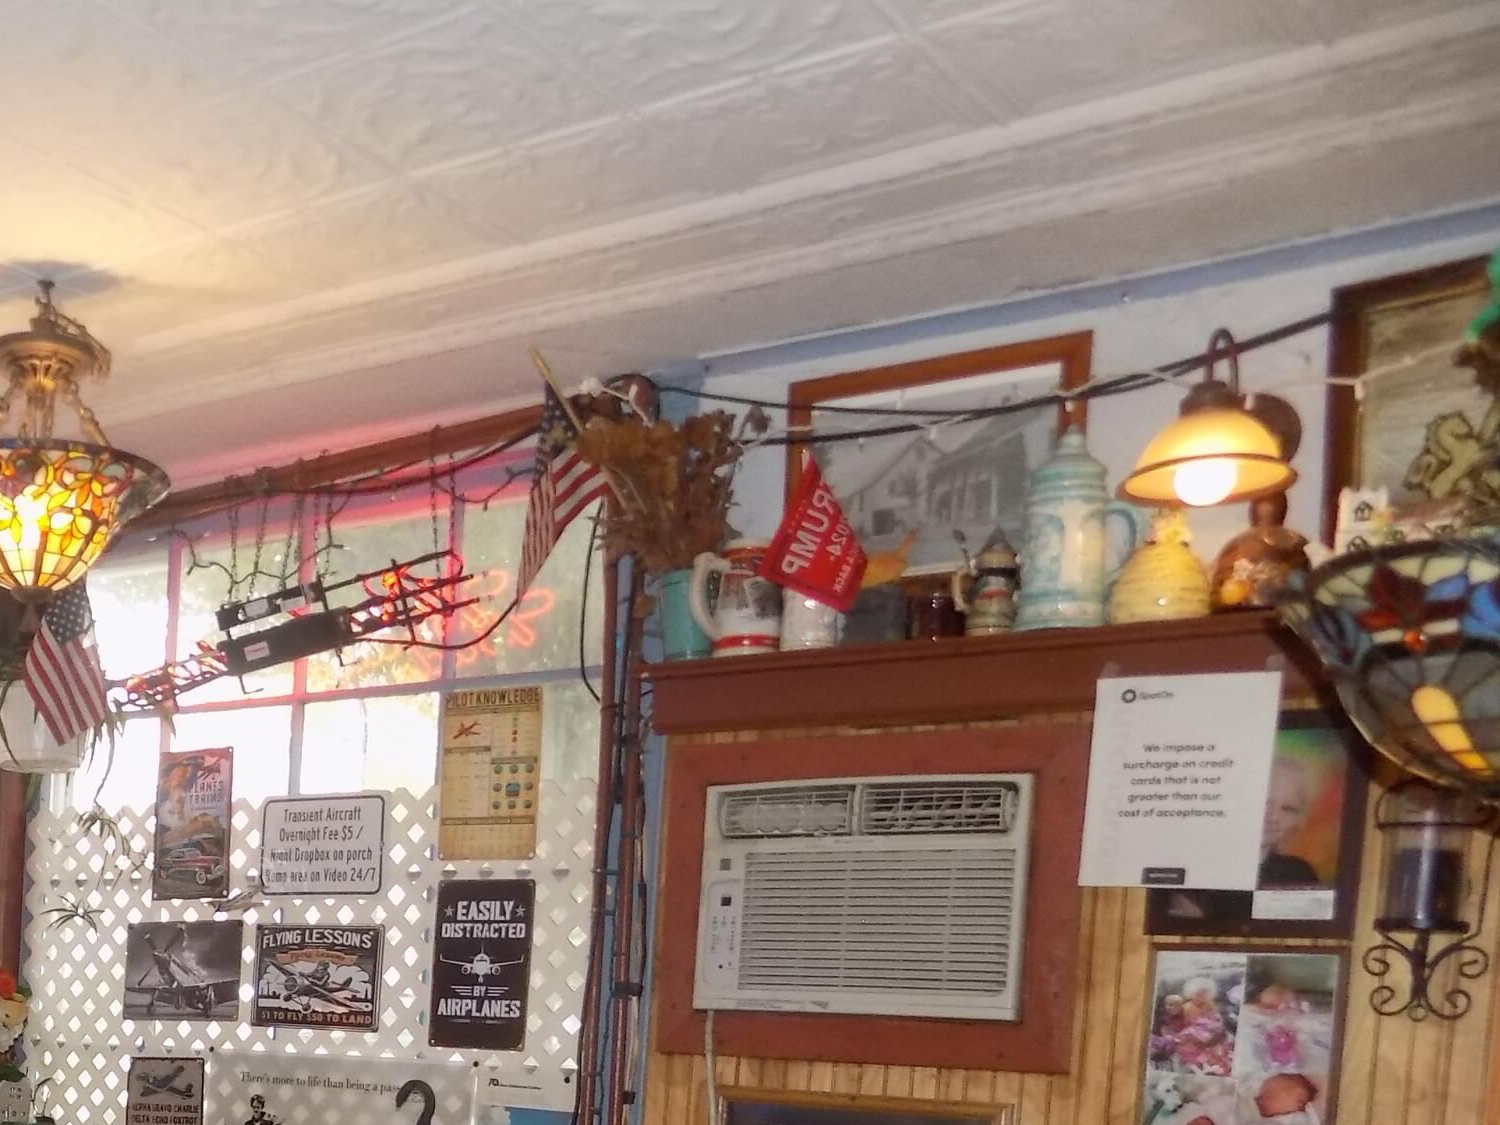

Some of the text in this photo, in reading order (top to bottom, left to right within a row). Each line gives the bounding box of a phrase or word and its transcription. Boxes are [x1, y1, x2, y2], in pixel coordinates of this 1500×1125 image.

[476, 688, 539, 705] KNOWLEDGE
[1143, 744, 1215, 754] We impose a
[1123, 758, 1234, 770] surcharge on credit
[1130, 775, 1222, 785] cards that is not
[1127, 792, 1221, 803] greater than our
[284, 806, 361, 823] Transient Aircraft
[1118, 808, 1225, 818] cost of acceptance.
[280, 827, 320, 845] Overnight
[323, 826, 338, 840] Fee
[341, 825, 353, 841] $5
[294, 847, 330, 865] Dropbox
[333, 849, 344, 861] on
[346, 846, 372, 865] porch
[310, 870, 320, 881] on
[323, 868, 347, 881] Video
[350, 867, 376, 882] 24/7
[456, 900, 514, 921] EASILY
[262, 928, 372, 949] FLYING LESSONS
[441, 922, 526, 939] DISTRACTED
[473, 985, 486, 997] BY
[437, 998, 521, 1018] AIRPLANES
[273, 1011, 285, 1020] TO
[287, 1012, 305, 1021] FLY
[326, 1013, 339, 1022] TO
[342, 1014, 372, 1025] LAND
[240, 1071, 270, 1083] There's
[272, 1076, 294, 1085] more
[296, 1076, 306, 1086] to
[307, 1075, 322, 1087] life
[323, 1076, 344, 1089] than
[346, 1077, 370, 1092] being
[174, 1104, 199, 1114] CHARLIE
